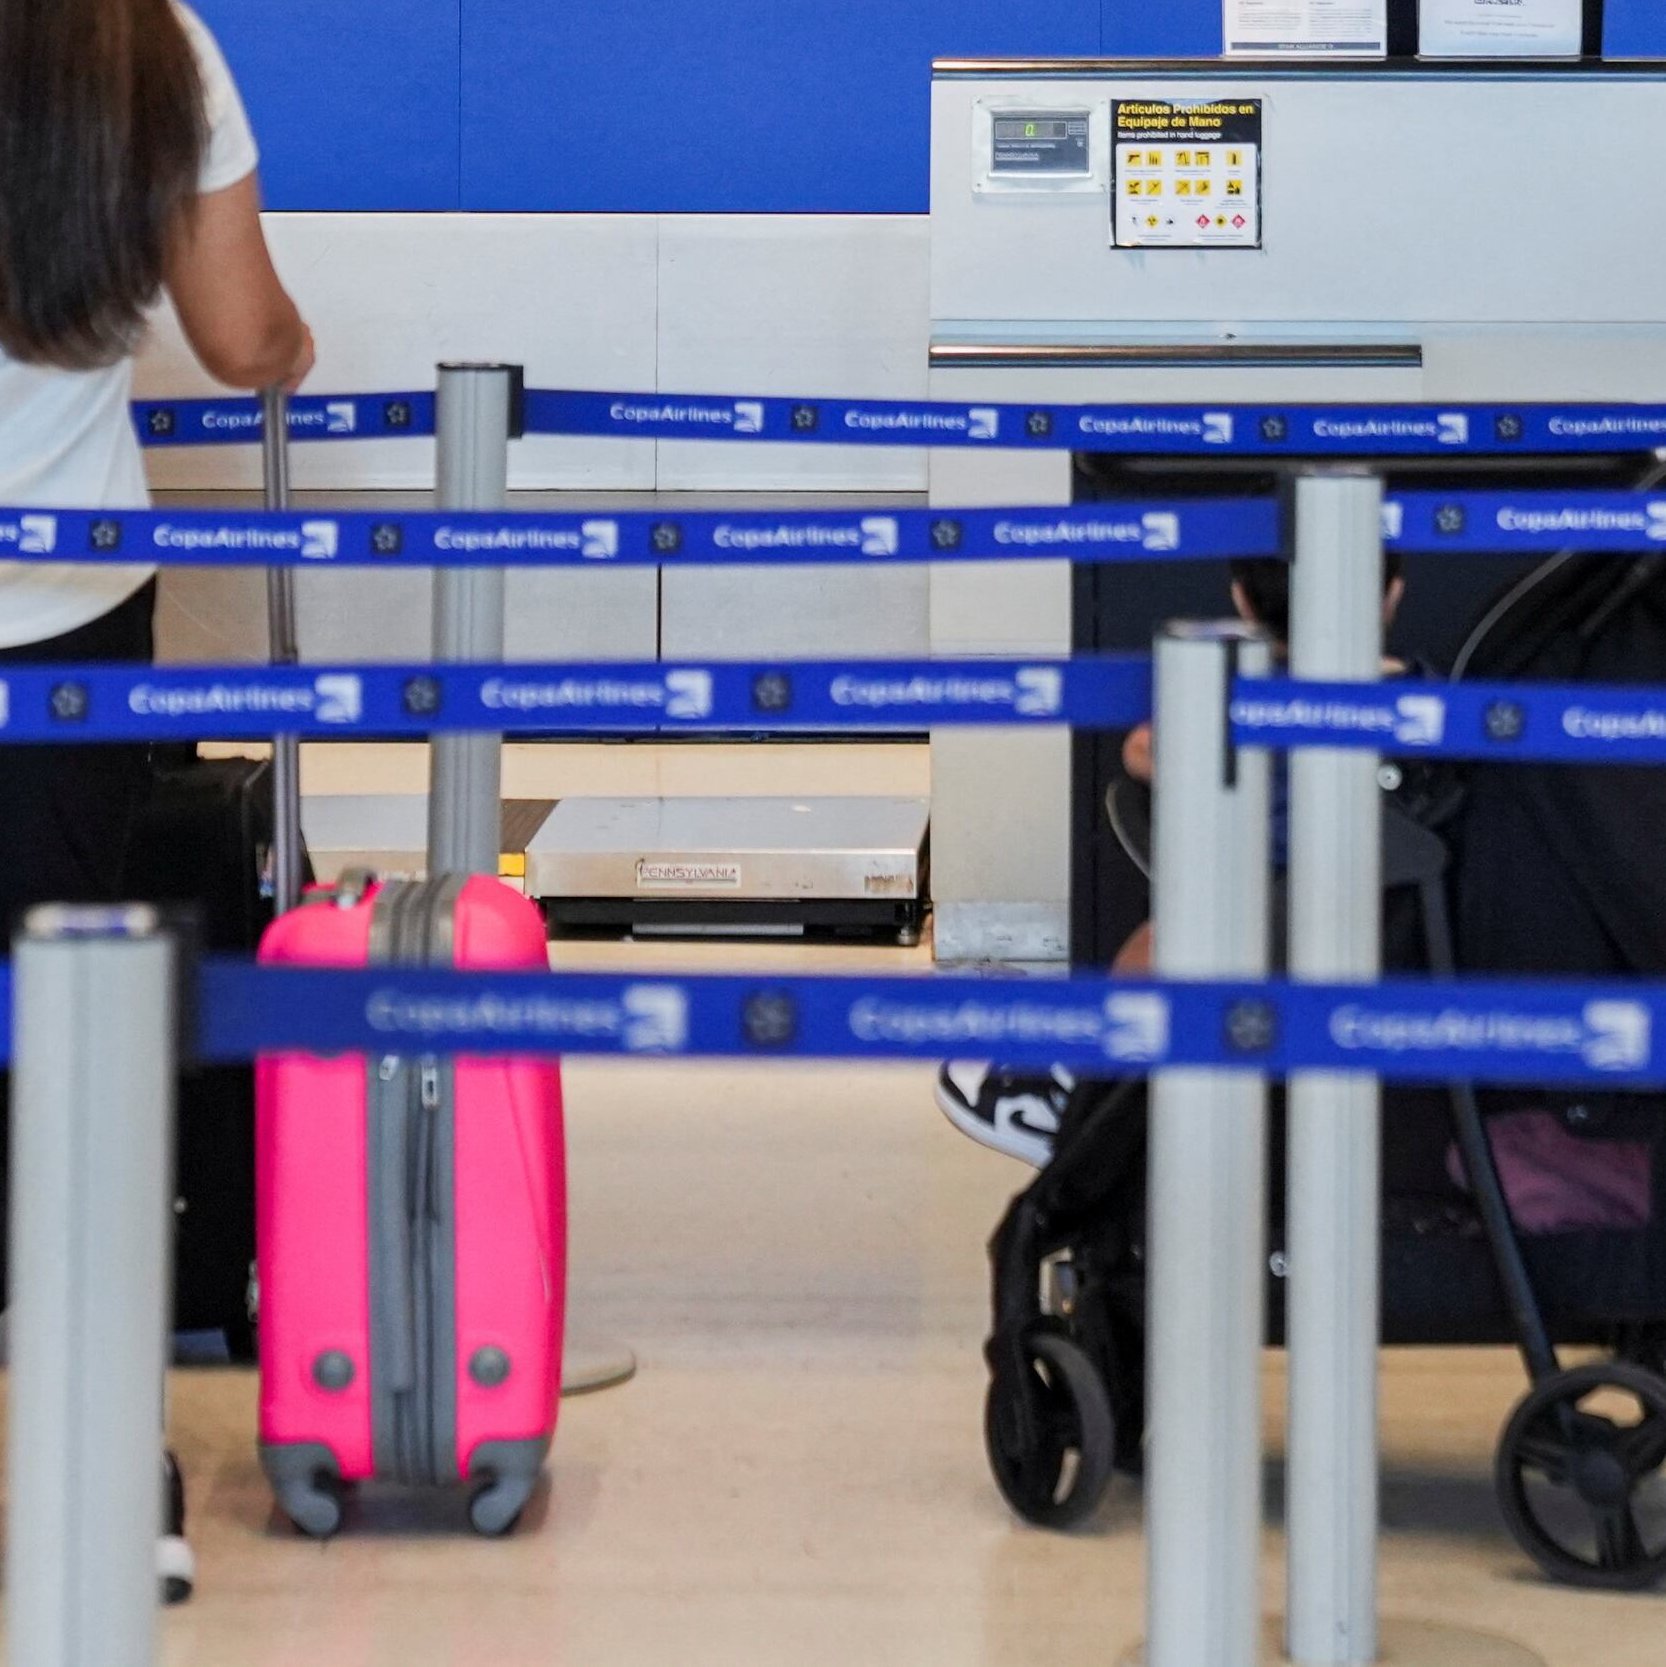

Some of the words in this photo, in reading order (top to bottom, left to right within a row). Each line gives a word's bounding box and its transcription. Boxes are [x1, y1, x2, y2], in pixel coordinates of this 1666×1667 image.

[1118, 116, 1168, 129] Equipaje
[1171, 116, 1185, 127] de
[1189, 116, 1221, 127] Mano
[1173, 104, 1236, 114] Prohibidos
[1239, 106, 1254, 114] en
[610, 402, 733, 426] CopaAirlines
[845, 410, 965, 432] CopaAirlines
[1079, 414, 1200, 437] CopaAirlines
[1313, 417, 1436, 439] CopaAirlines
[153, 526, 300, 552] CopaAirlines
[434, 527, 580, 553] CopaAirlines
[713, 526, 860, 551] CopaAirlines
[993, 521, 1141, 547] CopaAirlines
[129, 684, 315, 717] CopaAirlines
[480, 679, 665, 712] CopaAirlines
